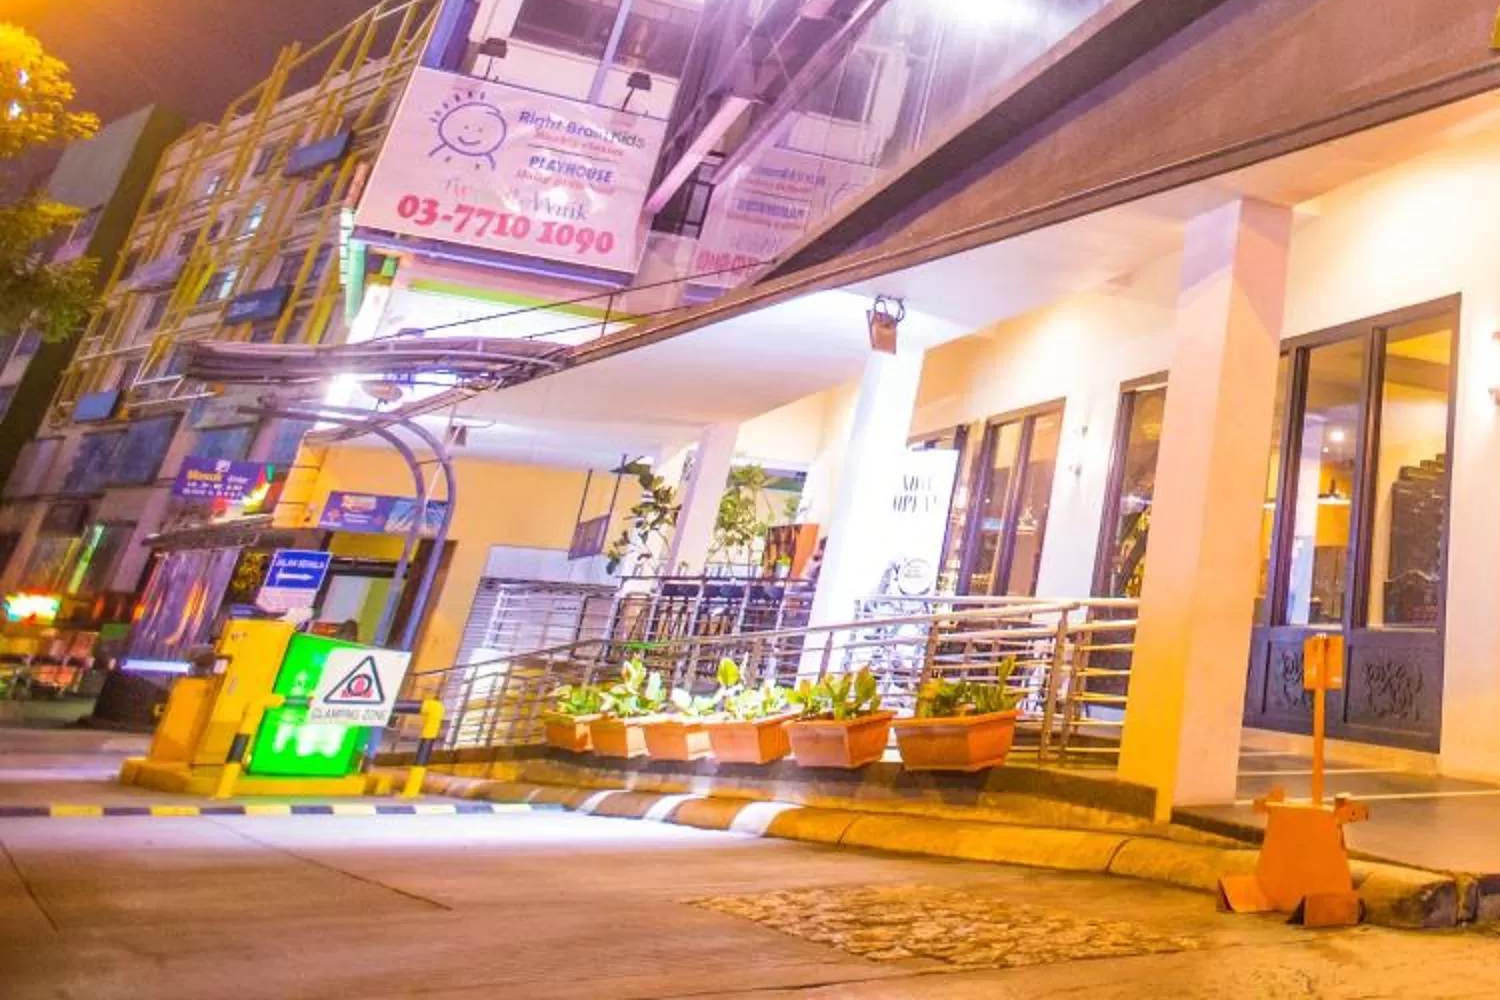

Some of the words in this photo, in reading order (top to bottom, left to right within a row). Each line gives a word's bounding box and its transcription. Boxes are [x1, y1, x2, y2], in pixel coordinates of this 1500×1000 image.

[518, 111, 563, 131] Right
[528, 155, 615, 183] PLAYHOUSE
[397, 194, 531, 239] 03-7710
[536, 221, 615, 254] 1090
